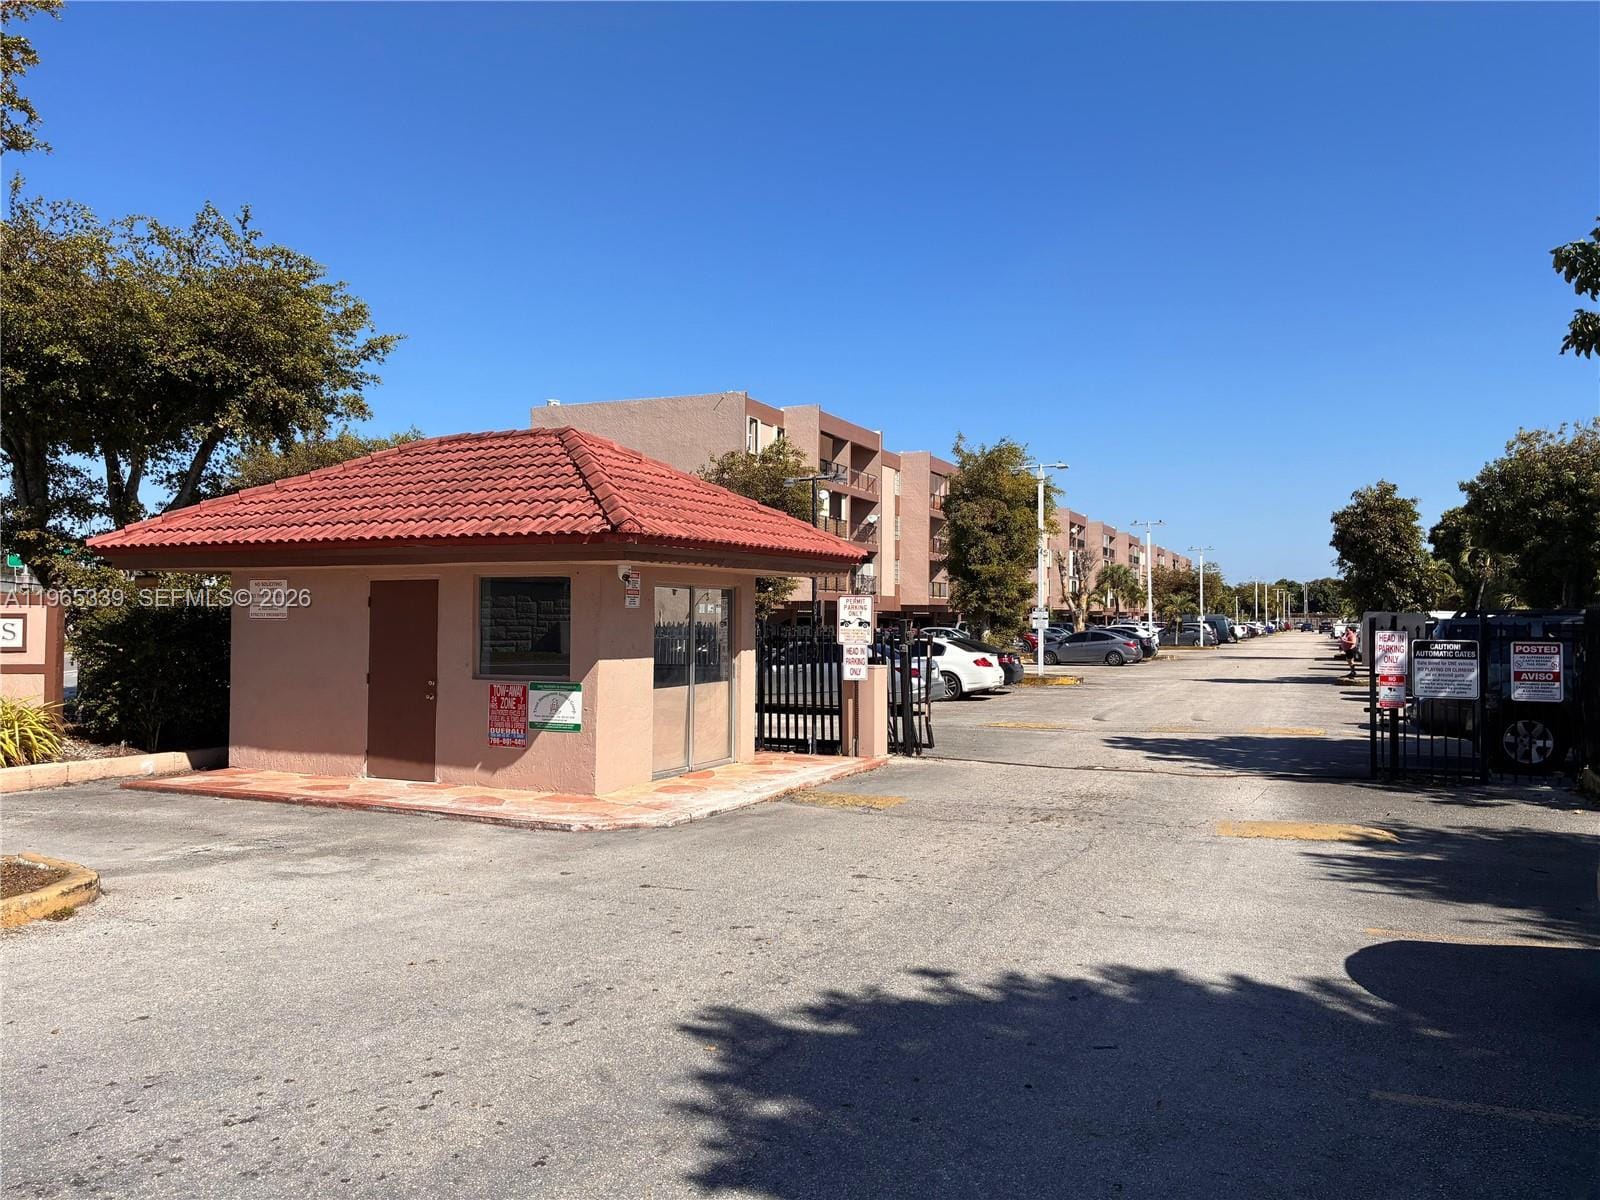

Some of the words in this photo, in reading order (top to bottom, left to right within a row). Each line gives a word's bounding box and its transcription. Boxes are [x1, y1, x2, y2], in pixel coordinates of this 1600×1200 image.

[2, 622, 16, 641] S
[1378, 634, 1396, 642] HEAD
[1398, 635, 1405, 643] IN
[846, 647, 859, 655] HEAD
[860, 647, 866, 655] IN
[1378, 645, 1405, 654] PARKING
[1515, 645, 1559, 653] POSTED
[845, 657, 865, 666] PARKING
[1383, 655, 1399, 663] ONLY
[849, 667, 862, 676] ONLY
[1520, 672, 1554, 681] AVISO
[493, 684, 524, 697] TOW-AWAY
[500, 696, 517, 710] ZONE
